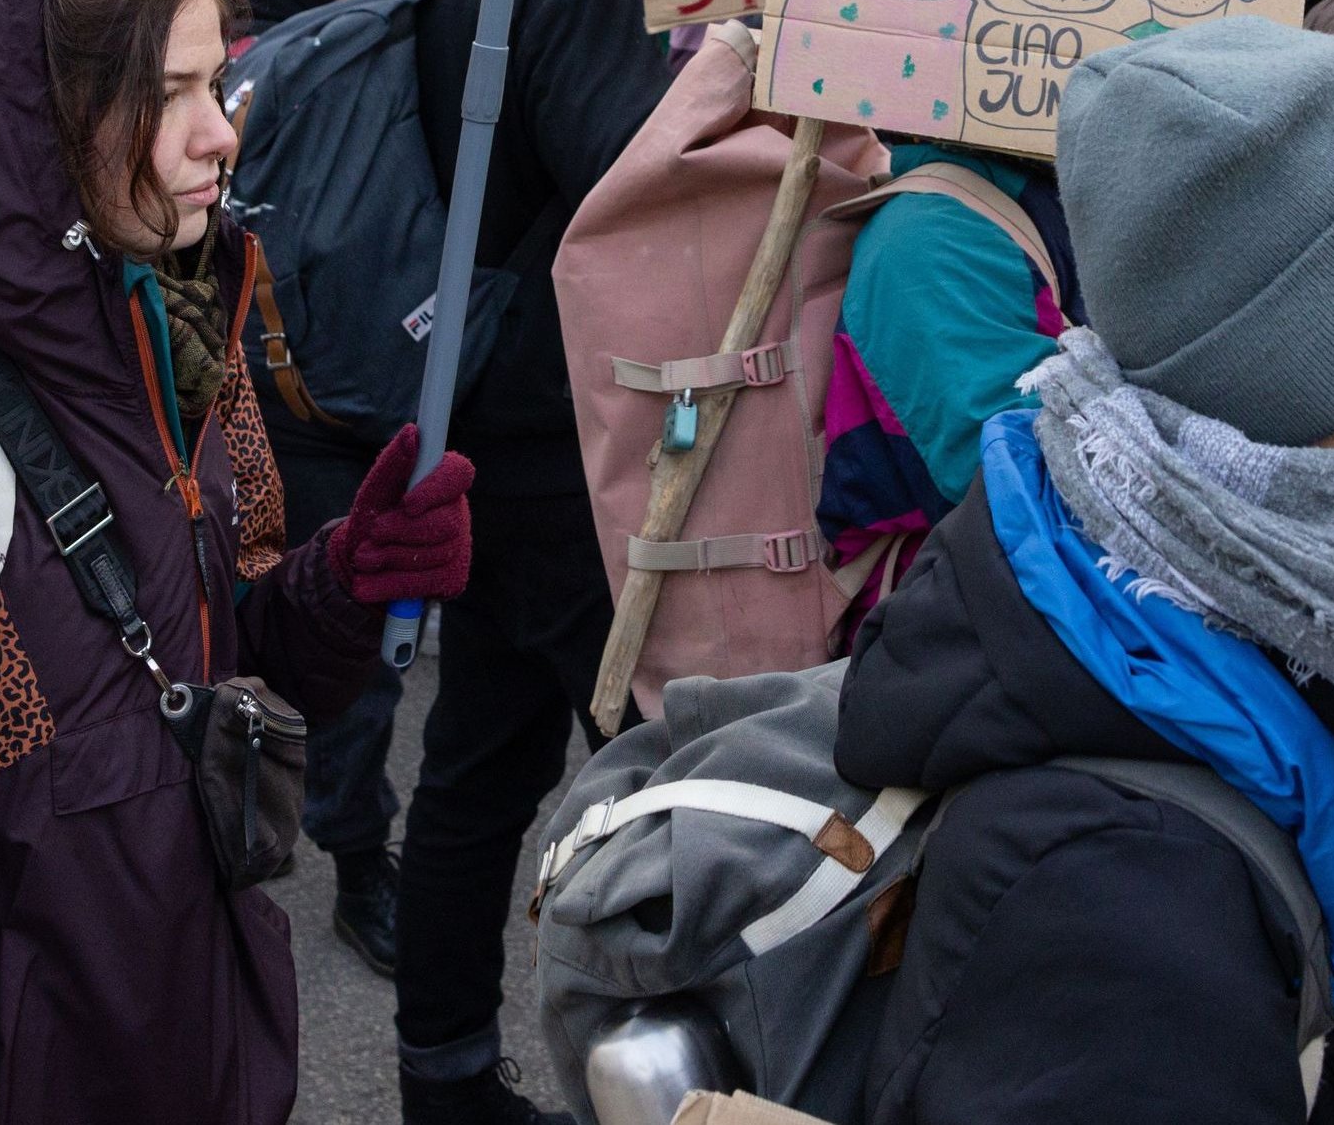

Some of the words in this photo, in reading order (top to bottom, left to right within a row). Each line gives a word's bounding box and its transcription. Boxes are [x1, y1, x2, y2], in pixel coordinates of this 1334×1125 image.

[976, 20, 1083, 69] CIAO
[979, 70, 1061, 117] JUN
[409, 310, 433, 334] FIL
